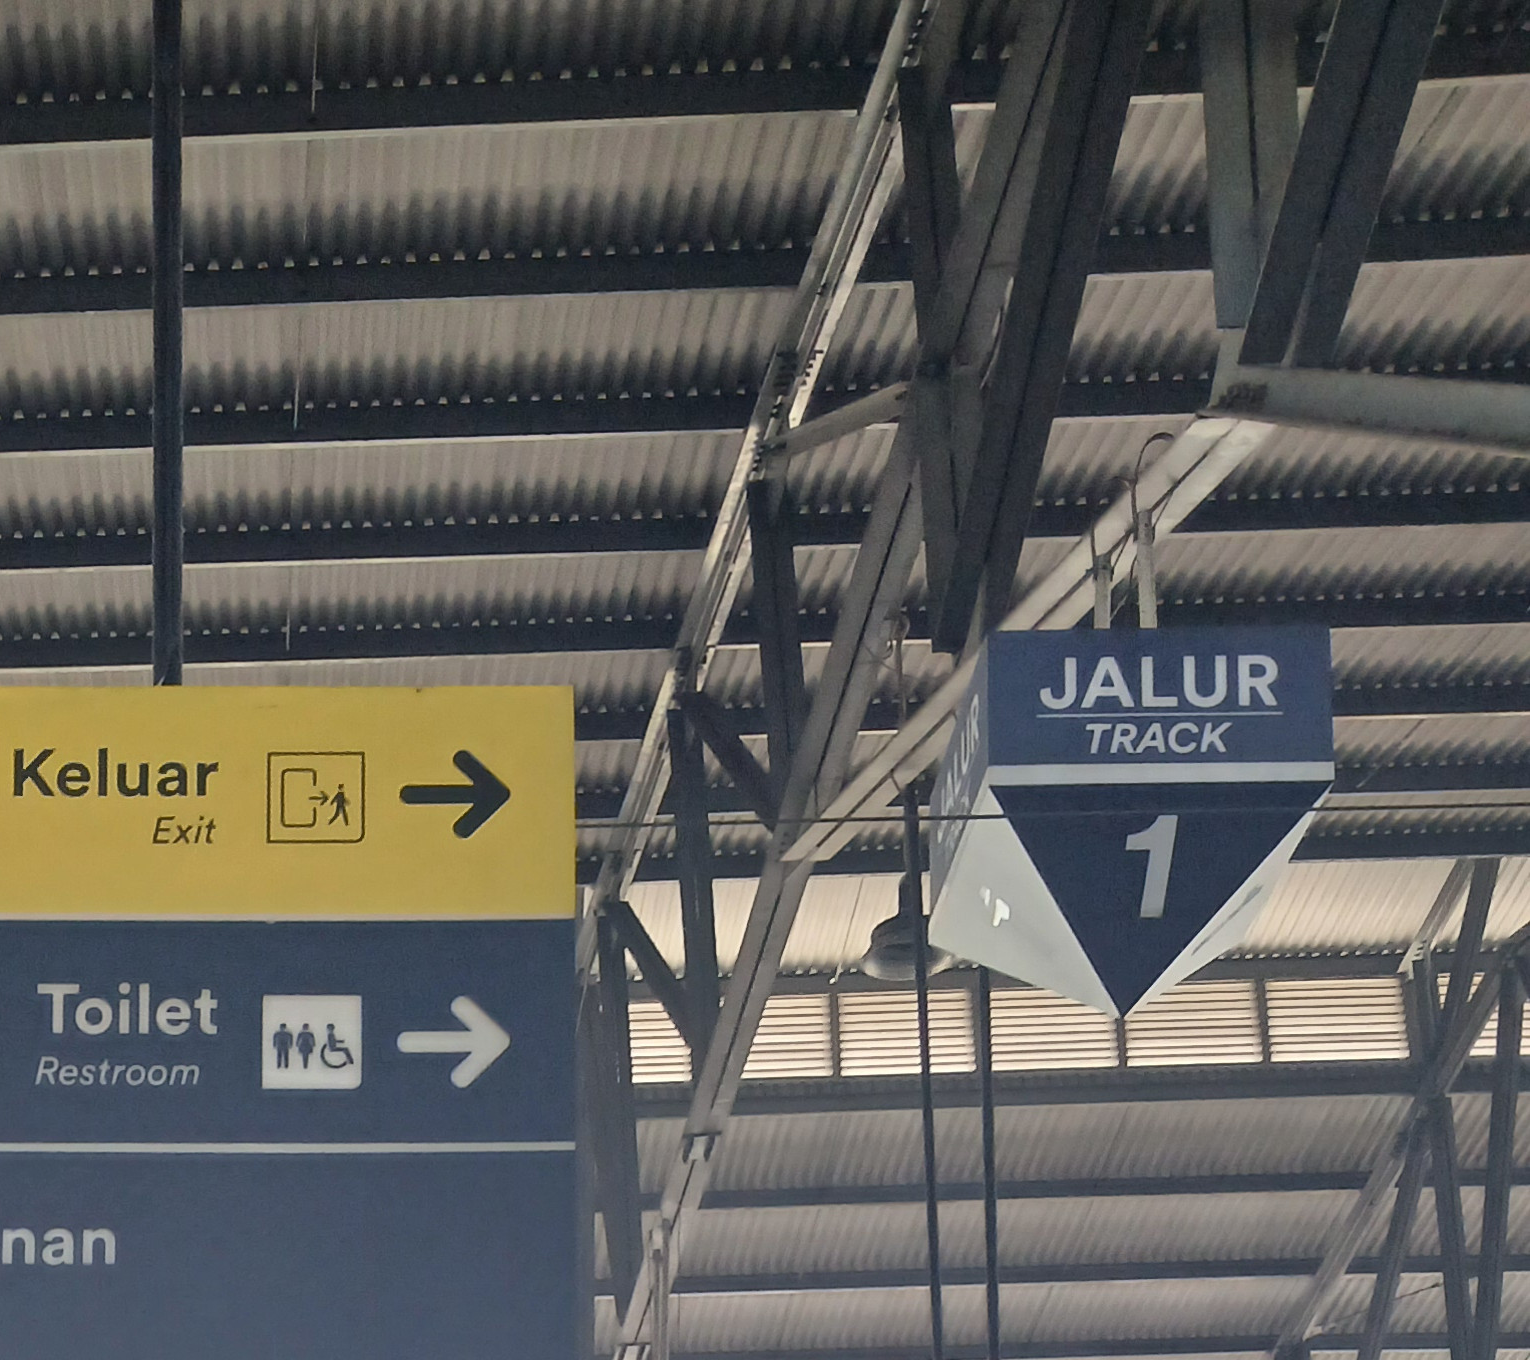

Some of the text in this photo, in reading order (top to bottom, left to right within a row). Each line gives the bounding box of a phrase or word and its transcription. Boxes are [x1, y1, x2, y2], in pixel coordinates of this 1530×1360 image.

[1039, 654, 1279, 710] JALUR
[1085, 721, 1232, 754] TRACK
[12, 747, 220, 798] Keluar
[152, 815, 217, 845] Exit
[1125, 814, 1179, 918] 1
[36, 982, 218, 1036] Toilet
[35, 1056, 200, 1086] Restroom
